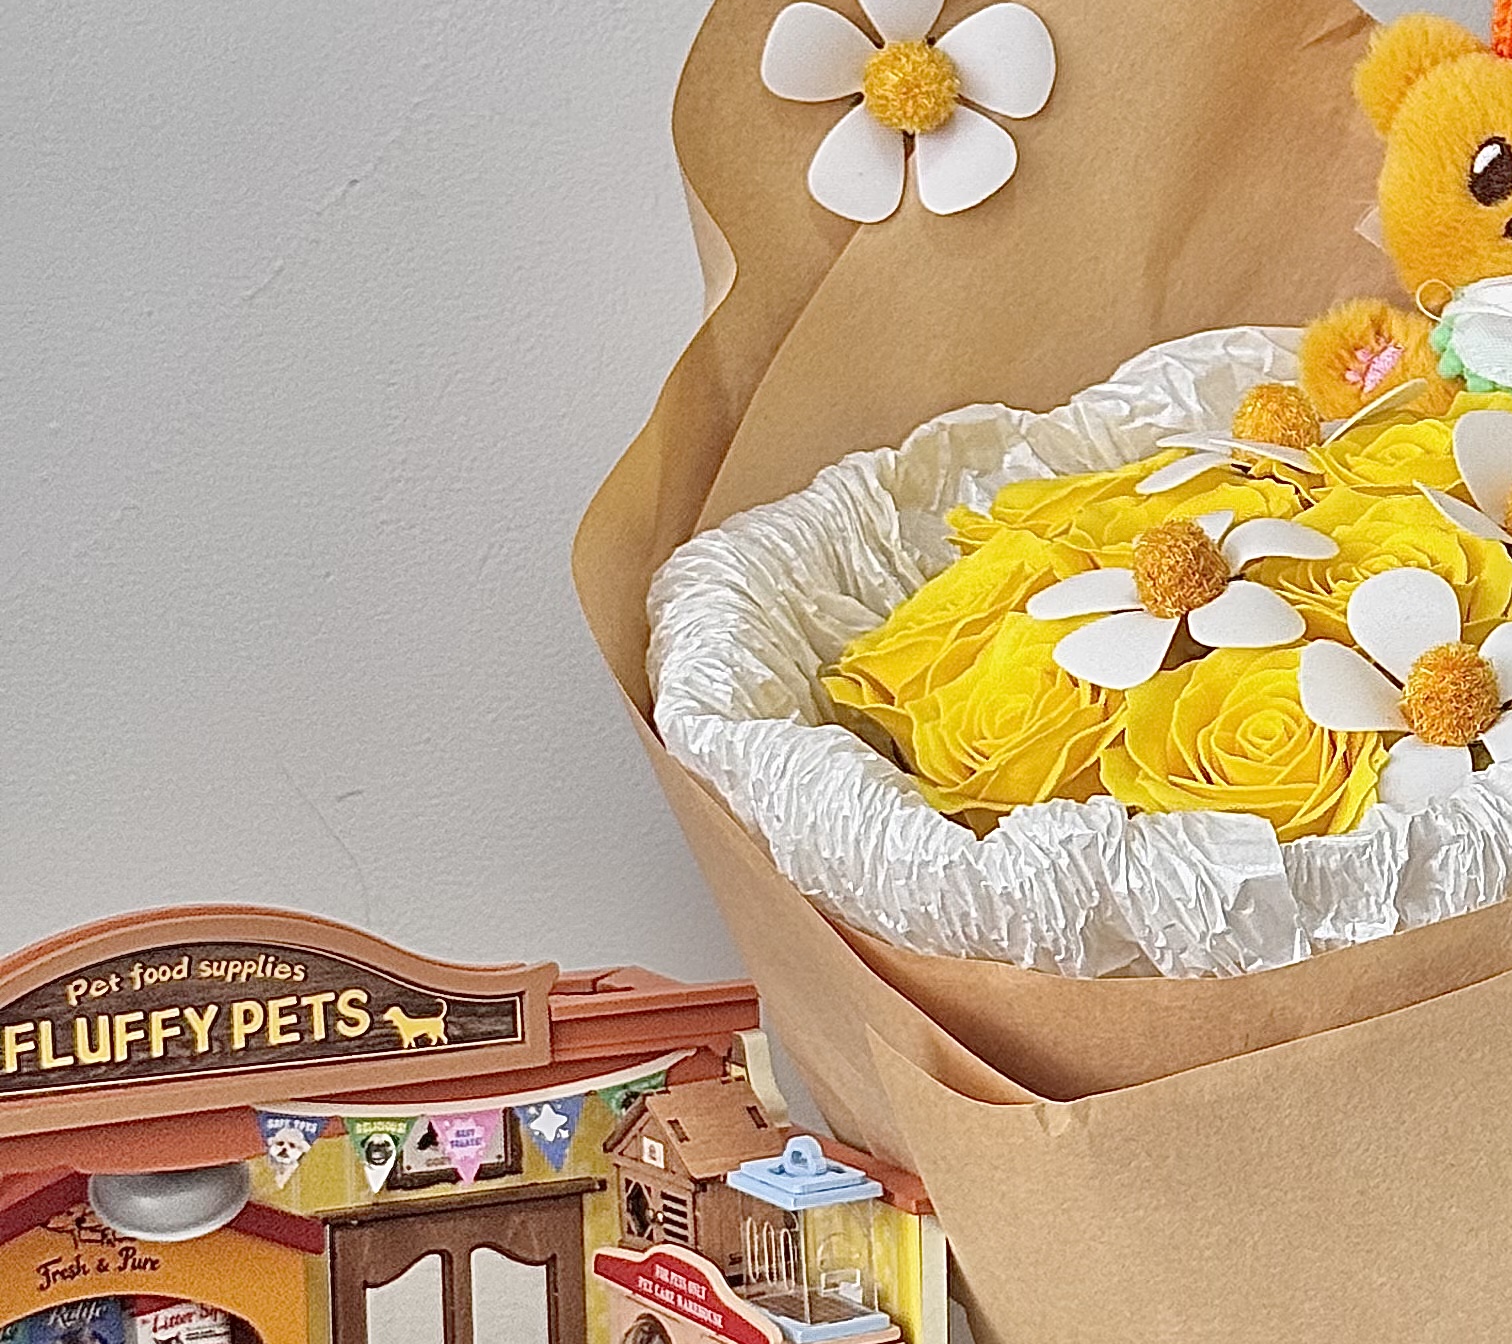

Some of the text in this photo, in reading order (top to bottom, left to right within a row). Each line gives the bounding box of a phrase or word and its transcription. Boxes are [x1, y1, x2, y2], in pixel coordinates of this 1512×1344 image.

[68, 954, 306, 1005] Pet food supplies
[4, 988, 372, 1073] FLUFFY PETS
[36, 1246, 161, 1291] Fresh & Pure
